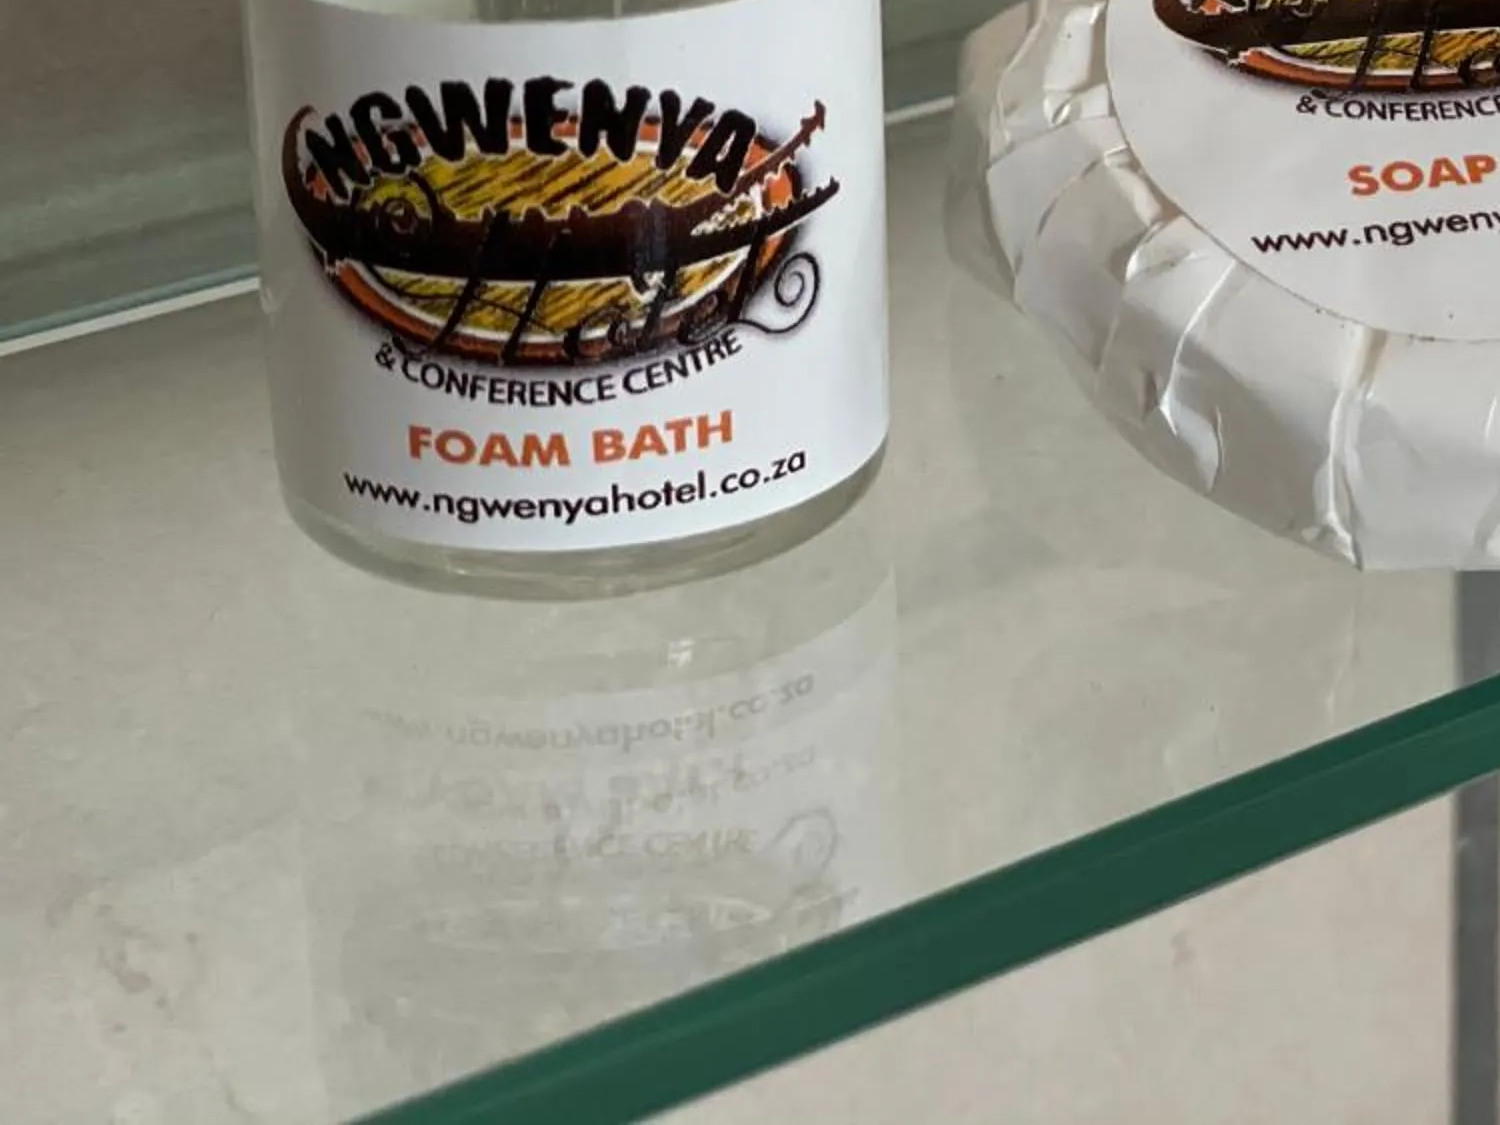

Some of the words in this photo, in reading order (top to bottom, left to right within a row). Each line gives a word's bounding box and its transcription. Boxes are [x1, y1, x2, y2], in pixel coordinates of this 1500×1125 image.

[306, 76, 757, 198] NGWENYA
[1296, 95, 1319, 114] &
[1349, 153, 1497, 196] SOAP
[375, 343, 397, 372] &
[401, 355, 617, 408] CONFERENCE
[622, 328, 743, 397] CENTRE
[408, 424, 570, 469] FOAM
[592, 409, 734, 463] BATH
[343, 450, 808, 525] www.ngwenyahotel.co.za
